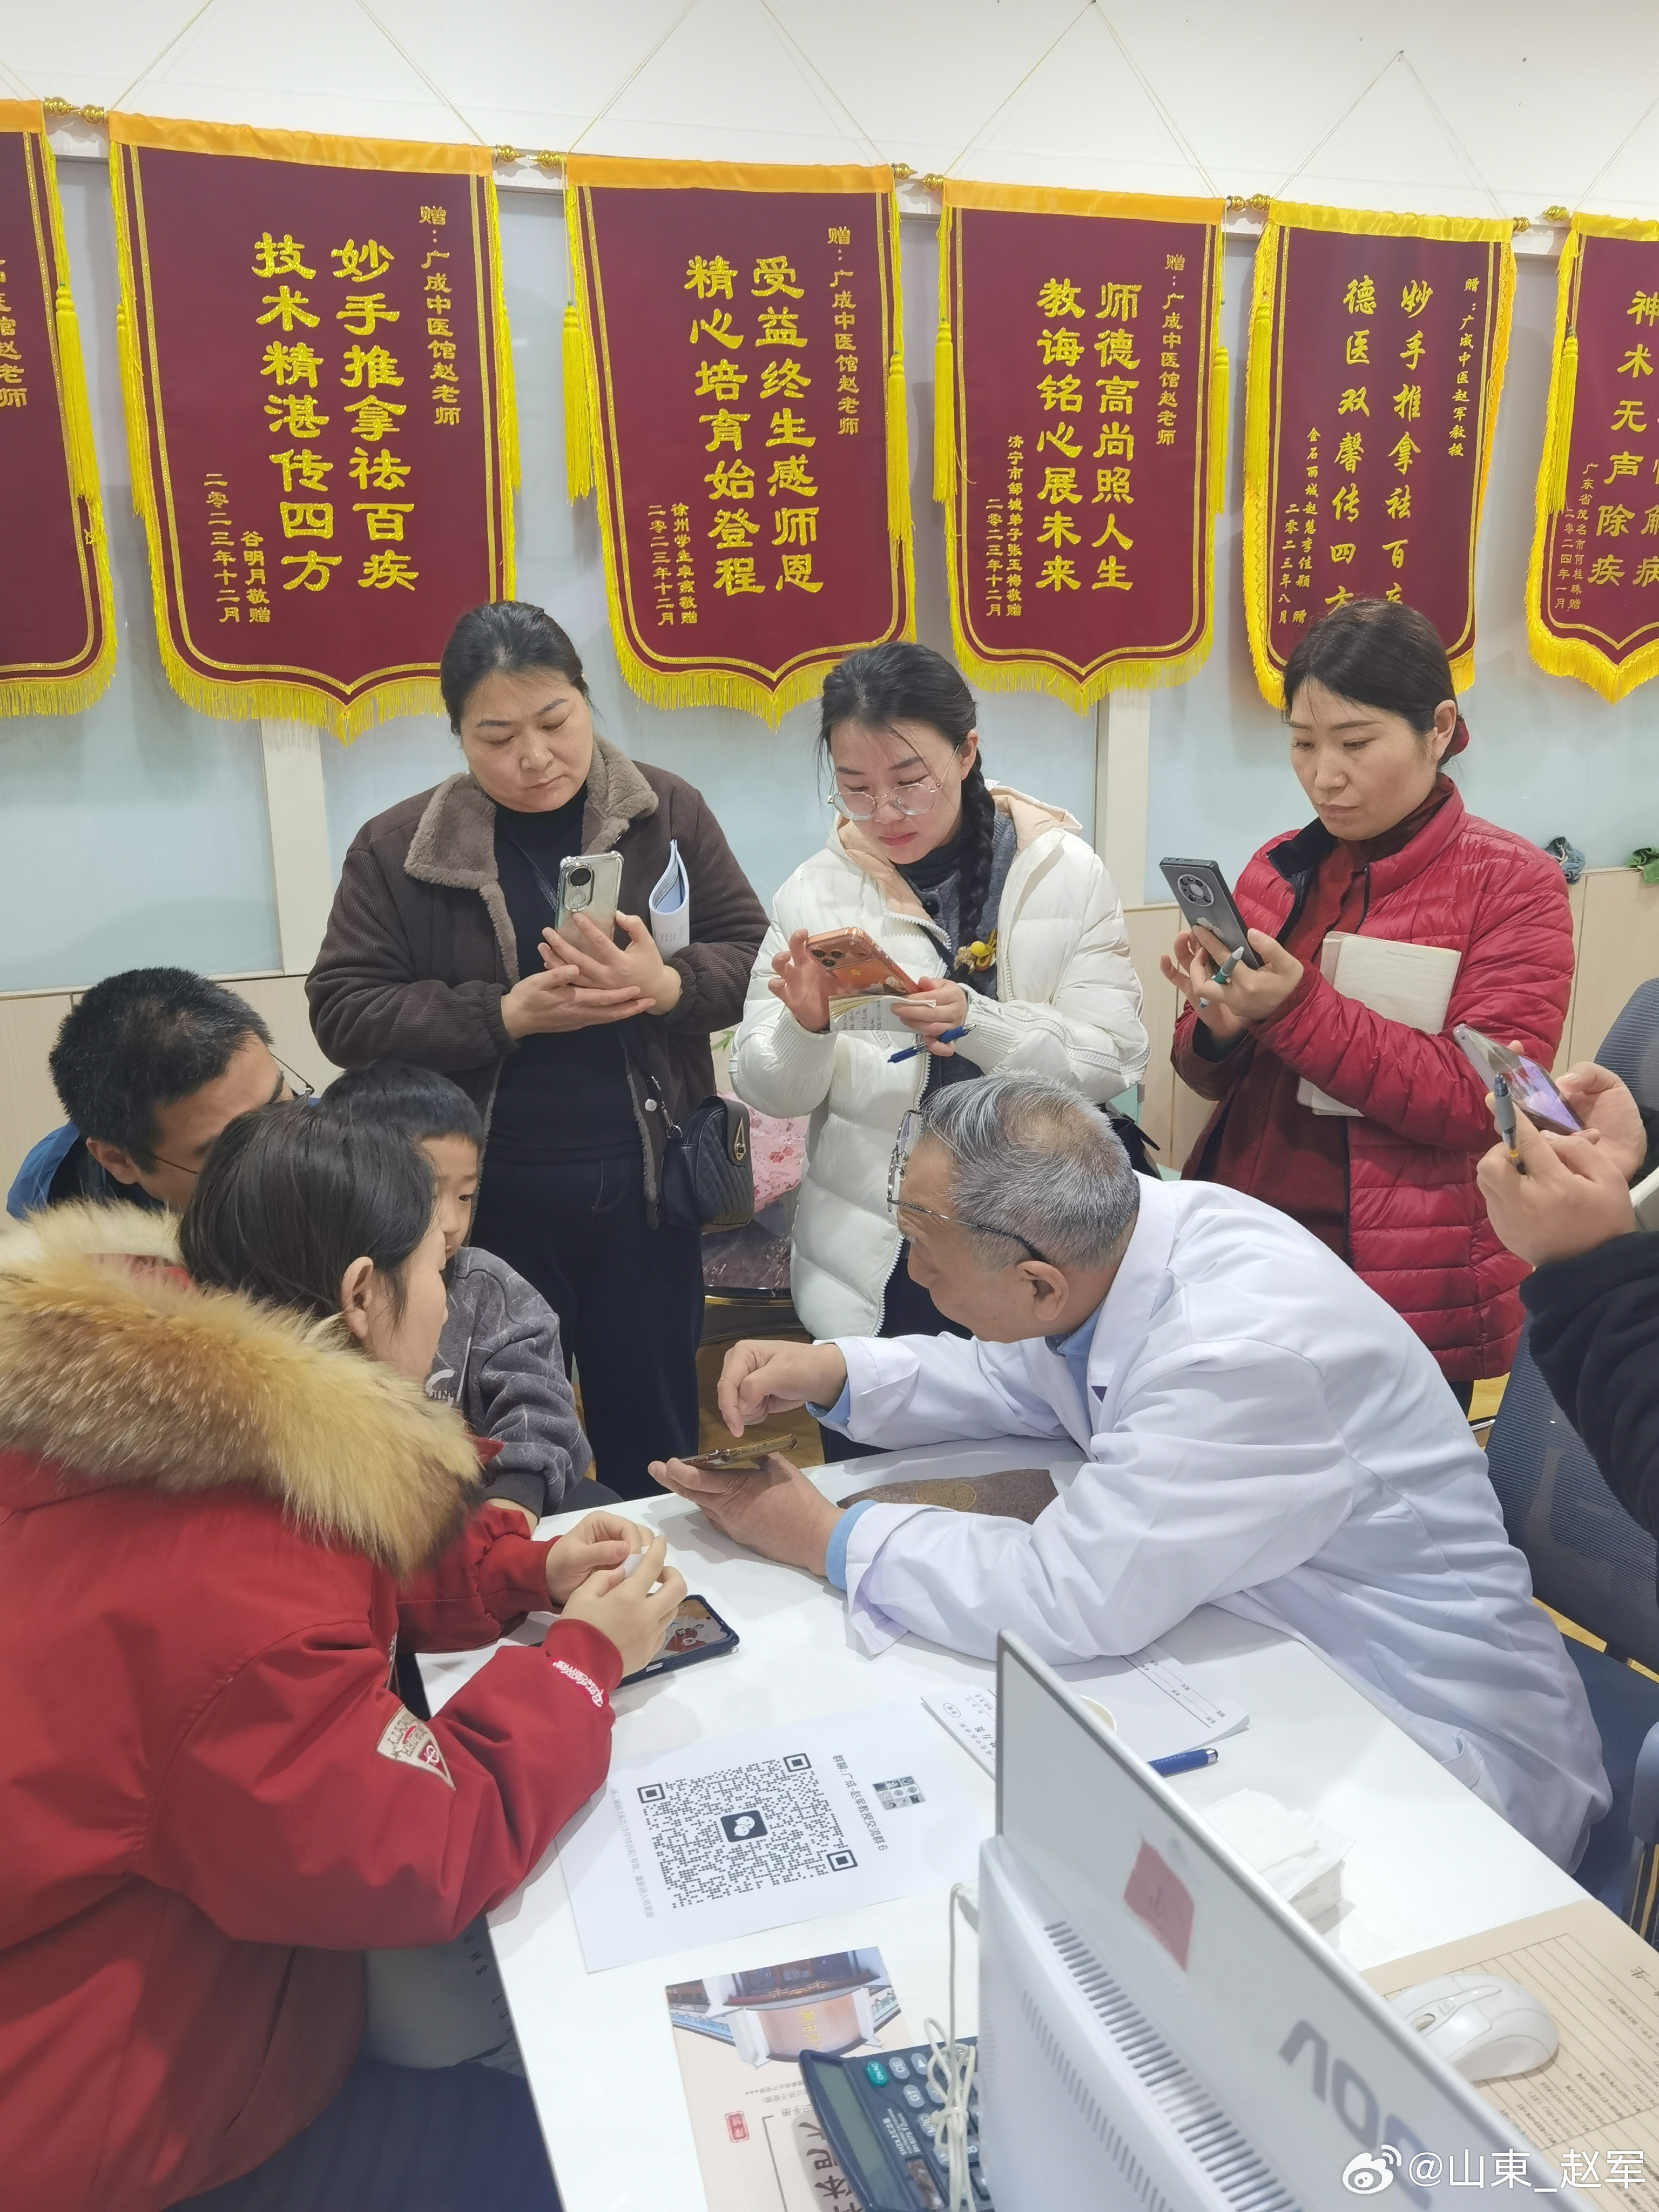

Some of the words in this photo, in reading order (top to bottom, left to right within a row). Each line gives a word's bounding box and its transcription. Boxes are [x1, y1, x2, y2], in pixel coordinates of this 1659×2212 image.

[252, 232, 342, 591] 技术精湛传四方
[331, 239, 419, 591] 妙手推拿祛百疾
[419, 207, 460, 426] 赠：广成中医馆赵老师
[828, 228, 859, 435] 赠：广成中医馆赵老师
[1157, 256, 1184, 445] 赠：广成中医馆赵老师
[684, 256, 765, 596] 精心培育始登程
[752, 256, 823, 593] 受益终生感师恩
[1035, 278, 1085, 591] 教诲铭心展未来
[1091, 282, 1142, 590] 师德高尚照人生
[1588, 292, 1659, 585] 神术无声除疾
[204, 474, 239, 622] 二零二三年十二月
[241, 531, 270, 623] 谷明月敬赠
[648, 505, 673, 625] 二零二三年十二月
[986, 500, 1003, 616] 二零二三年十二月
[1279, 504, 1299, 623] 二零二三年八月
[1555, 509, 1575, 609] 二零二四年一月
